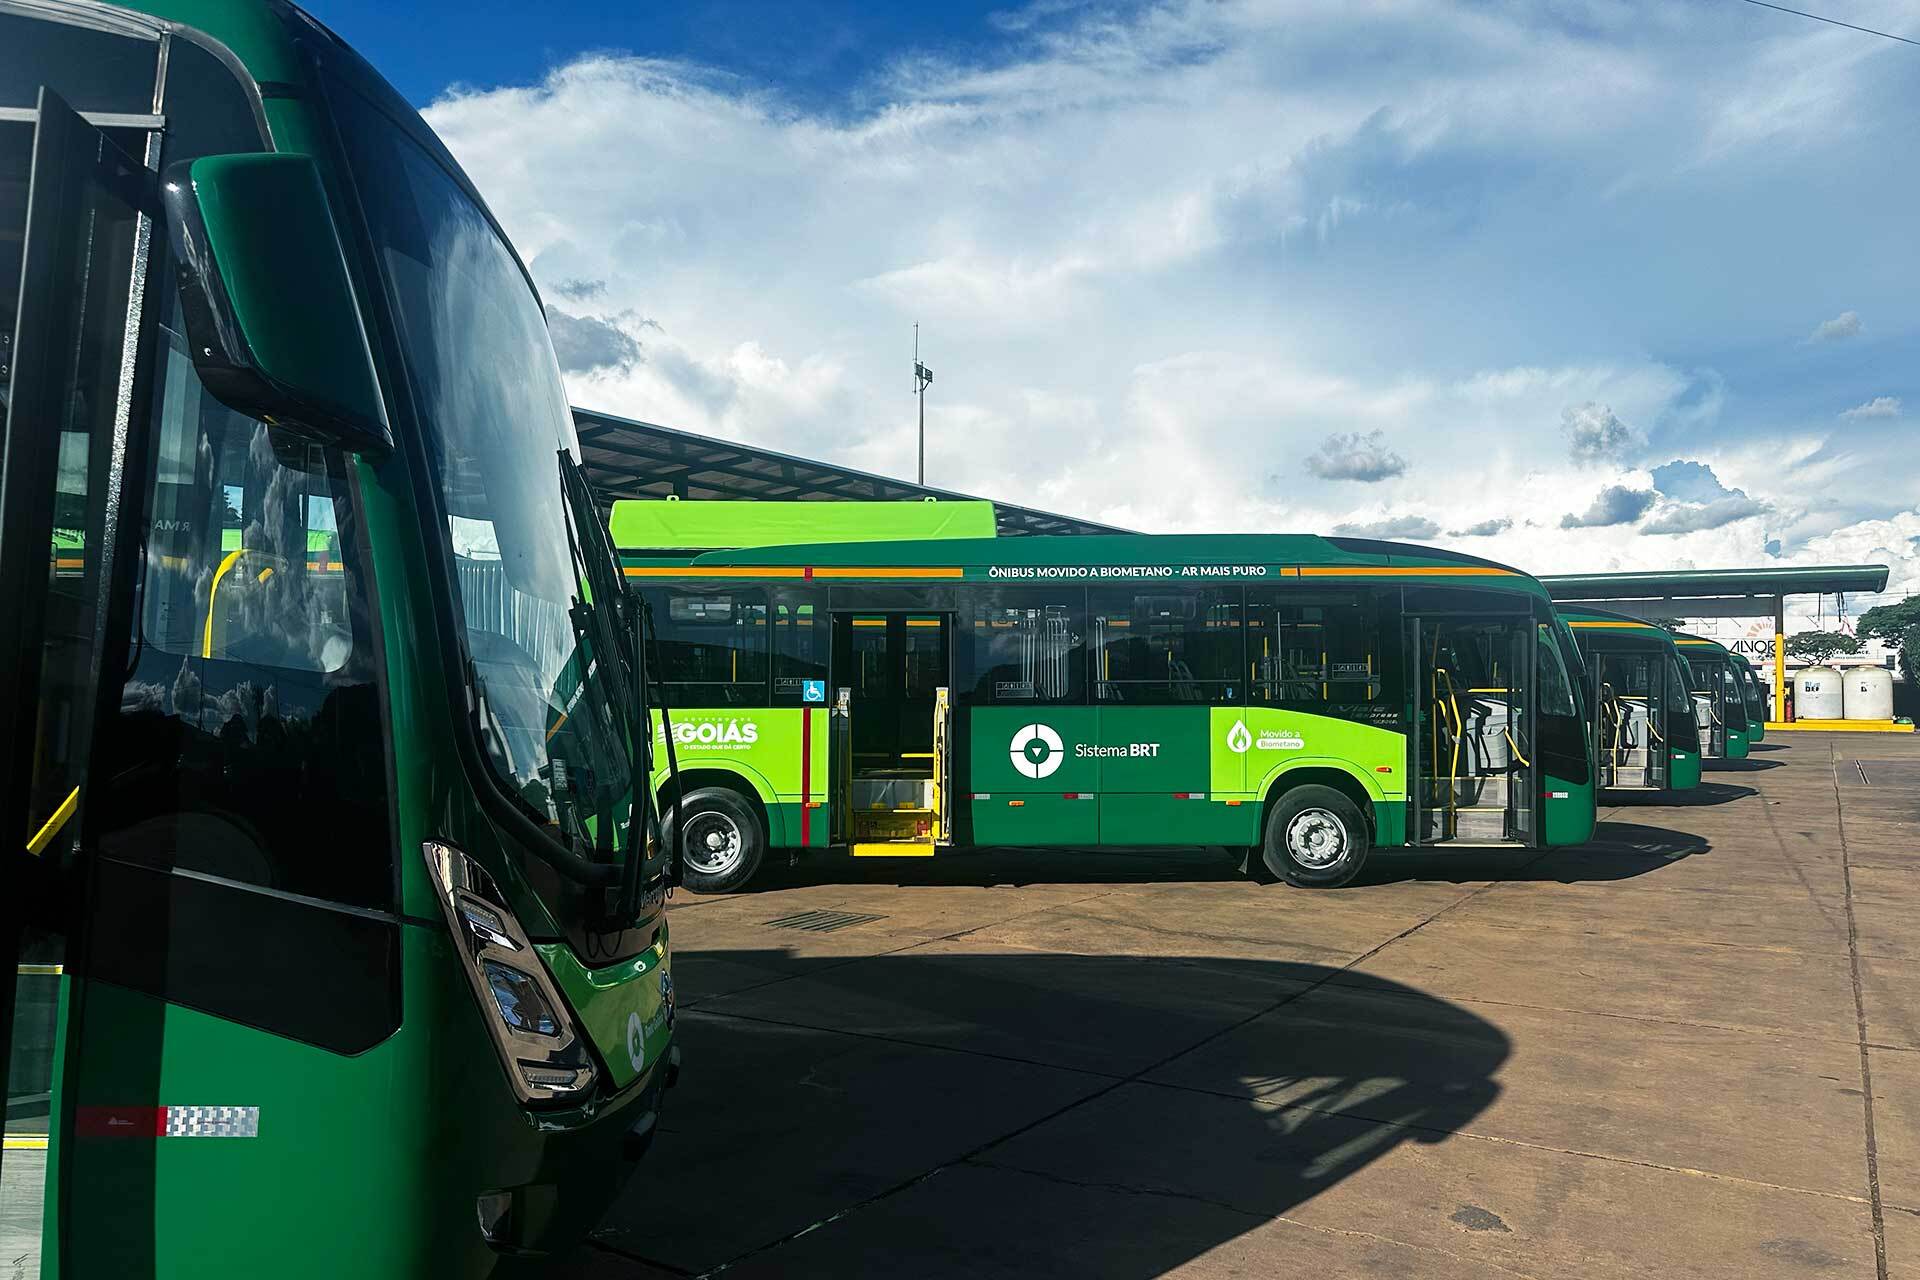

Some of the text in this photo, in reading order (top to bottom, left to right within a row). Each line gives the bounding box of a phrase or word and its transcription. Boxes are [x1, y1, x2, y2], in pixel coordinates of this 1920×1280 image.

[988, 566, 1034, 578] ÔNIBUS
[1036, 567, 1087, 577] MOVIDO
[1089, 567, 1098, 577] A
[1100, 567, 1173, 577] BIOMETANO
[1181, 567, 1199, 577] AR
[1200, 566, 1231, 576] MAIS
[1232, 566, 1266, 576] PURO
[677, 719, 758, 743] GOIÁS
[1260, 729, 1293, 738] Movido
[1075, 743, 1160, 757] Sistema BRT
[1260, 740, 1301, 748] Biometano
